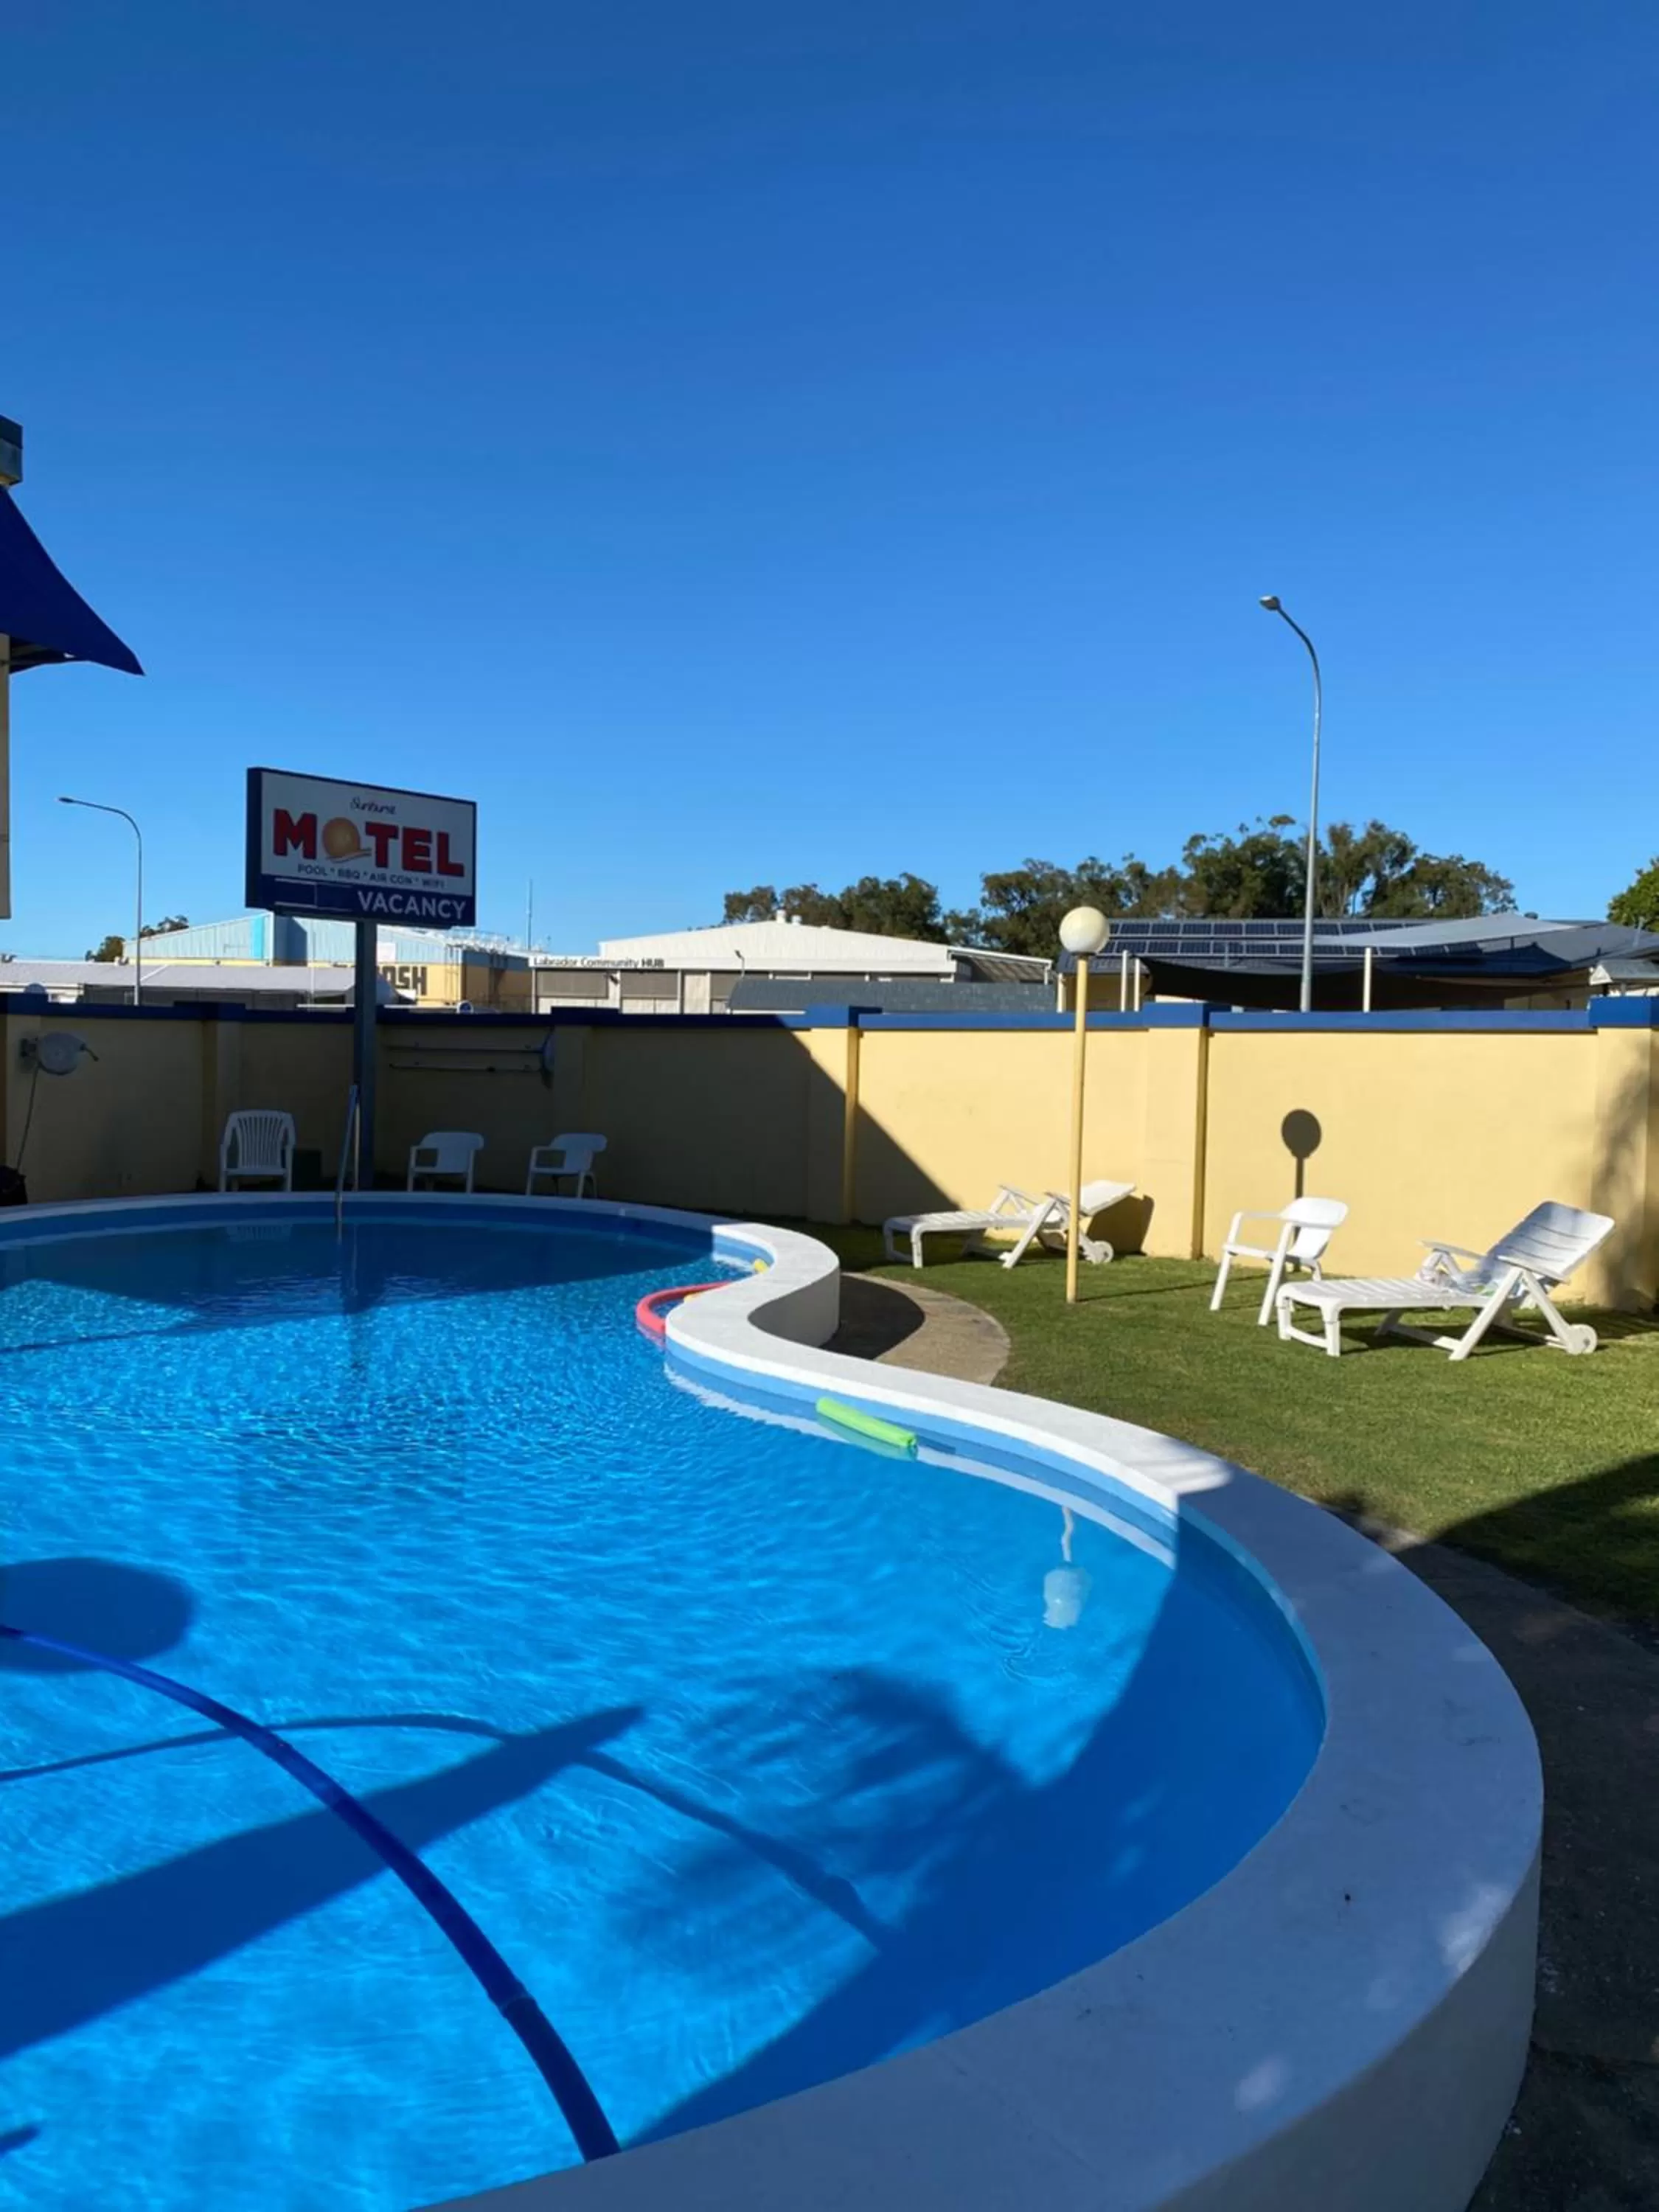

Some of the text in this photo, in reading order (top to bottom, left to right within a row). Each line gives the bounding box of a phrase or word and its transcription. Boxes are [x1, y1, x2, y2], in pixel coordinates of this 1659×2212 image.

[273, 808, 465, 877] MOTEL
[297, 863, 328, 876] POOL
[338, 868, 360, 880] BBQ
[369, 872, 387, 883] AIR
[389, 874, 413, 885] CON
[357, 890, 466, 919] VACANCY
[534, 957, 664, 969] Labrador Community HUB
